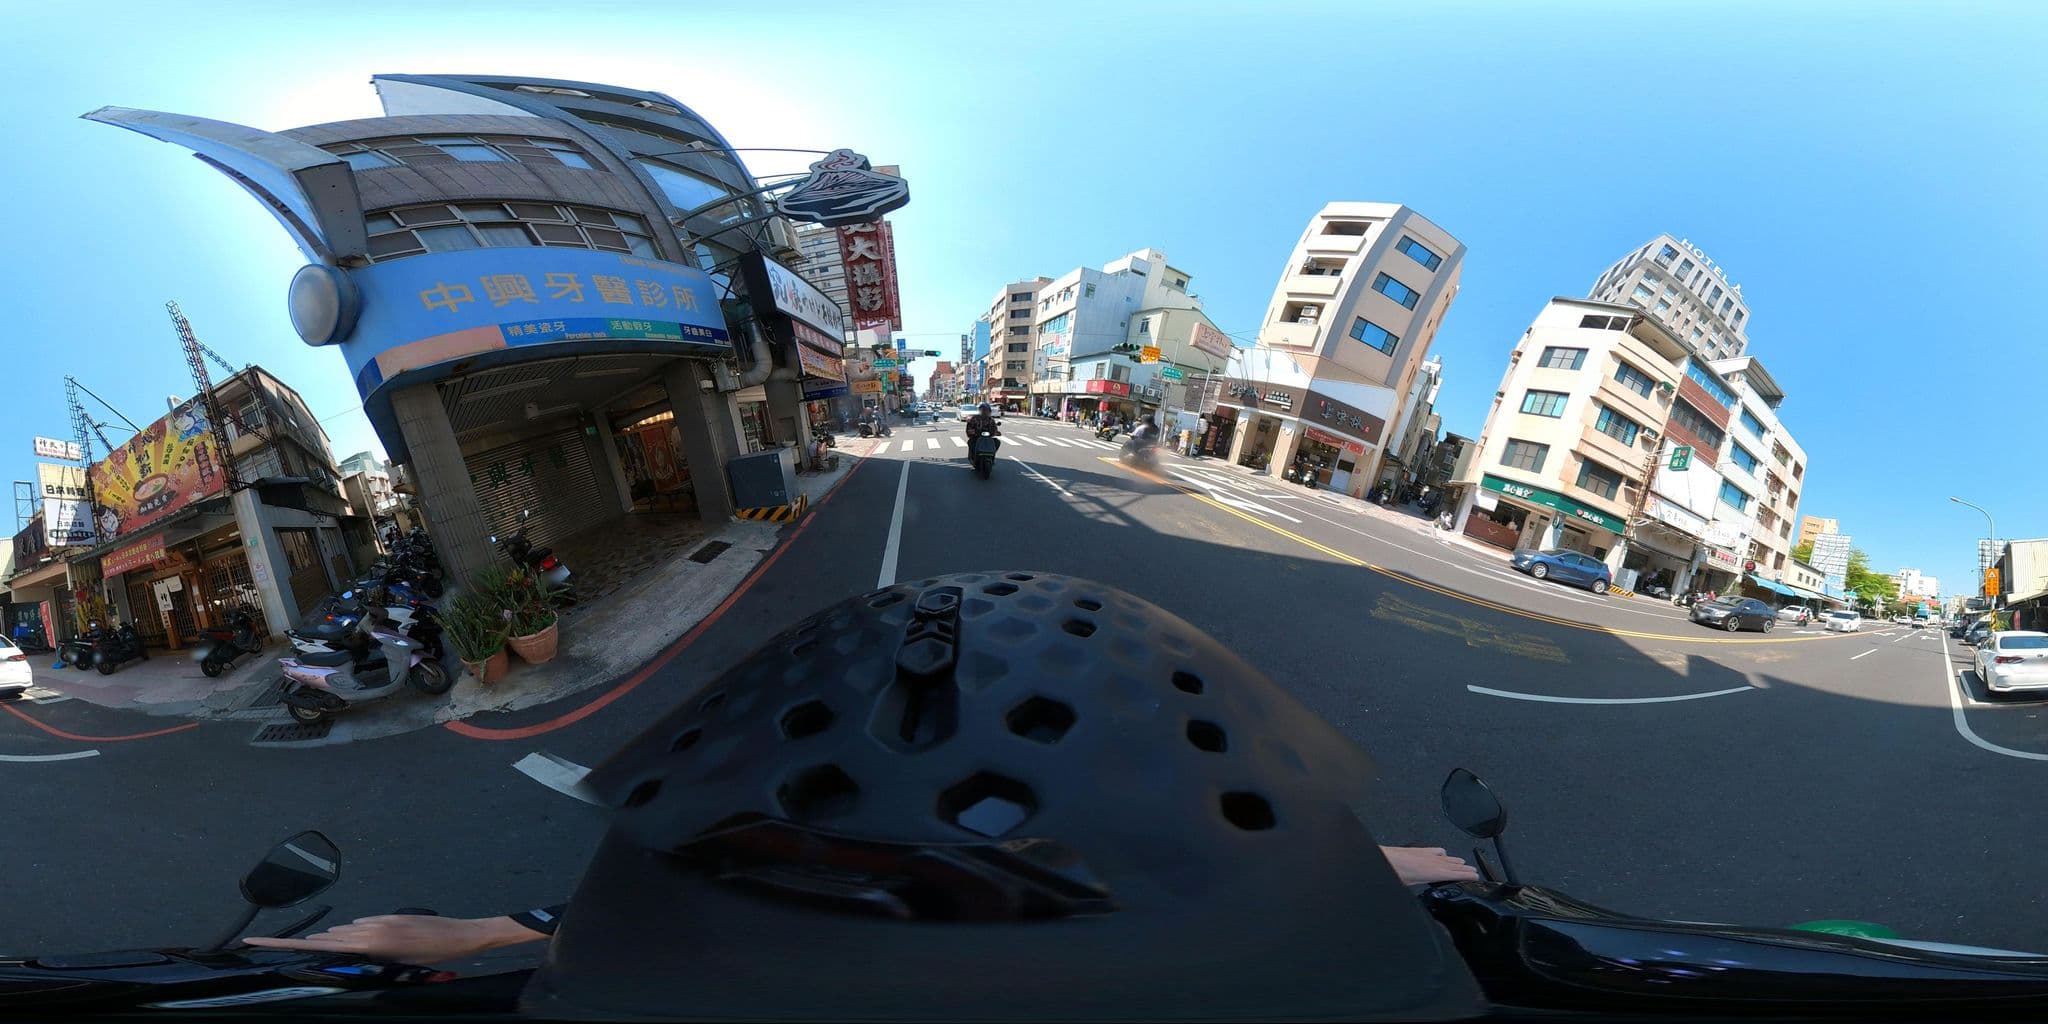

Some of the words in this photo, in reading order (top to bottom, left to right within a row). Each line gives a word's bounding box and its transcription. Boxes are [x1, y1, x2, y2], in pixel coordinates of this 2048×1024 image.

[1681, 238, 1729, 285] HOTEL
[420, 272, 700, 313] 中興牙醫診所
[507, 321, 567, 337] 精美瓷牙
